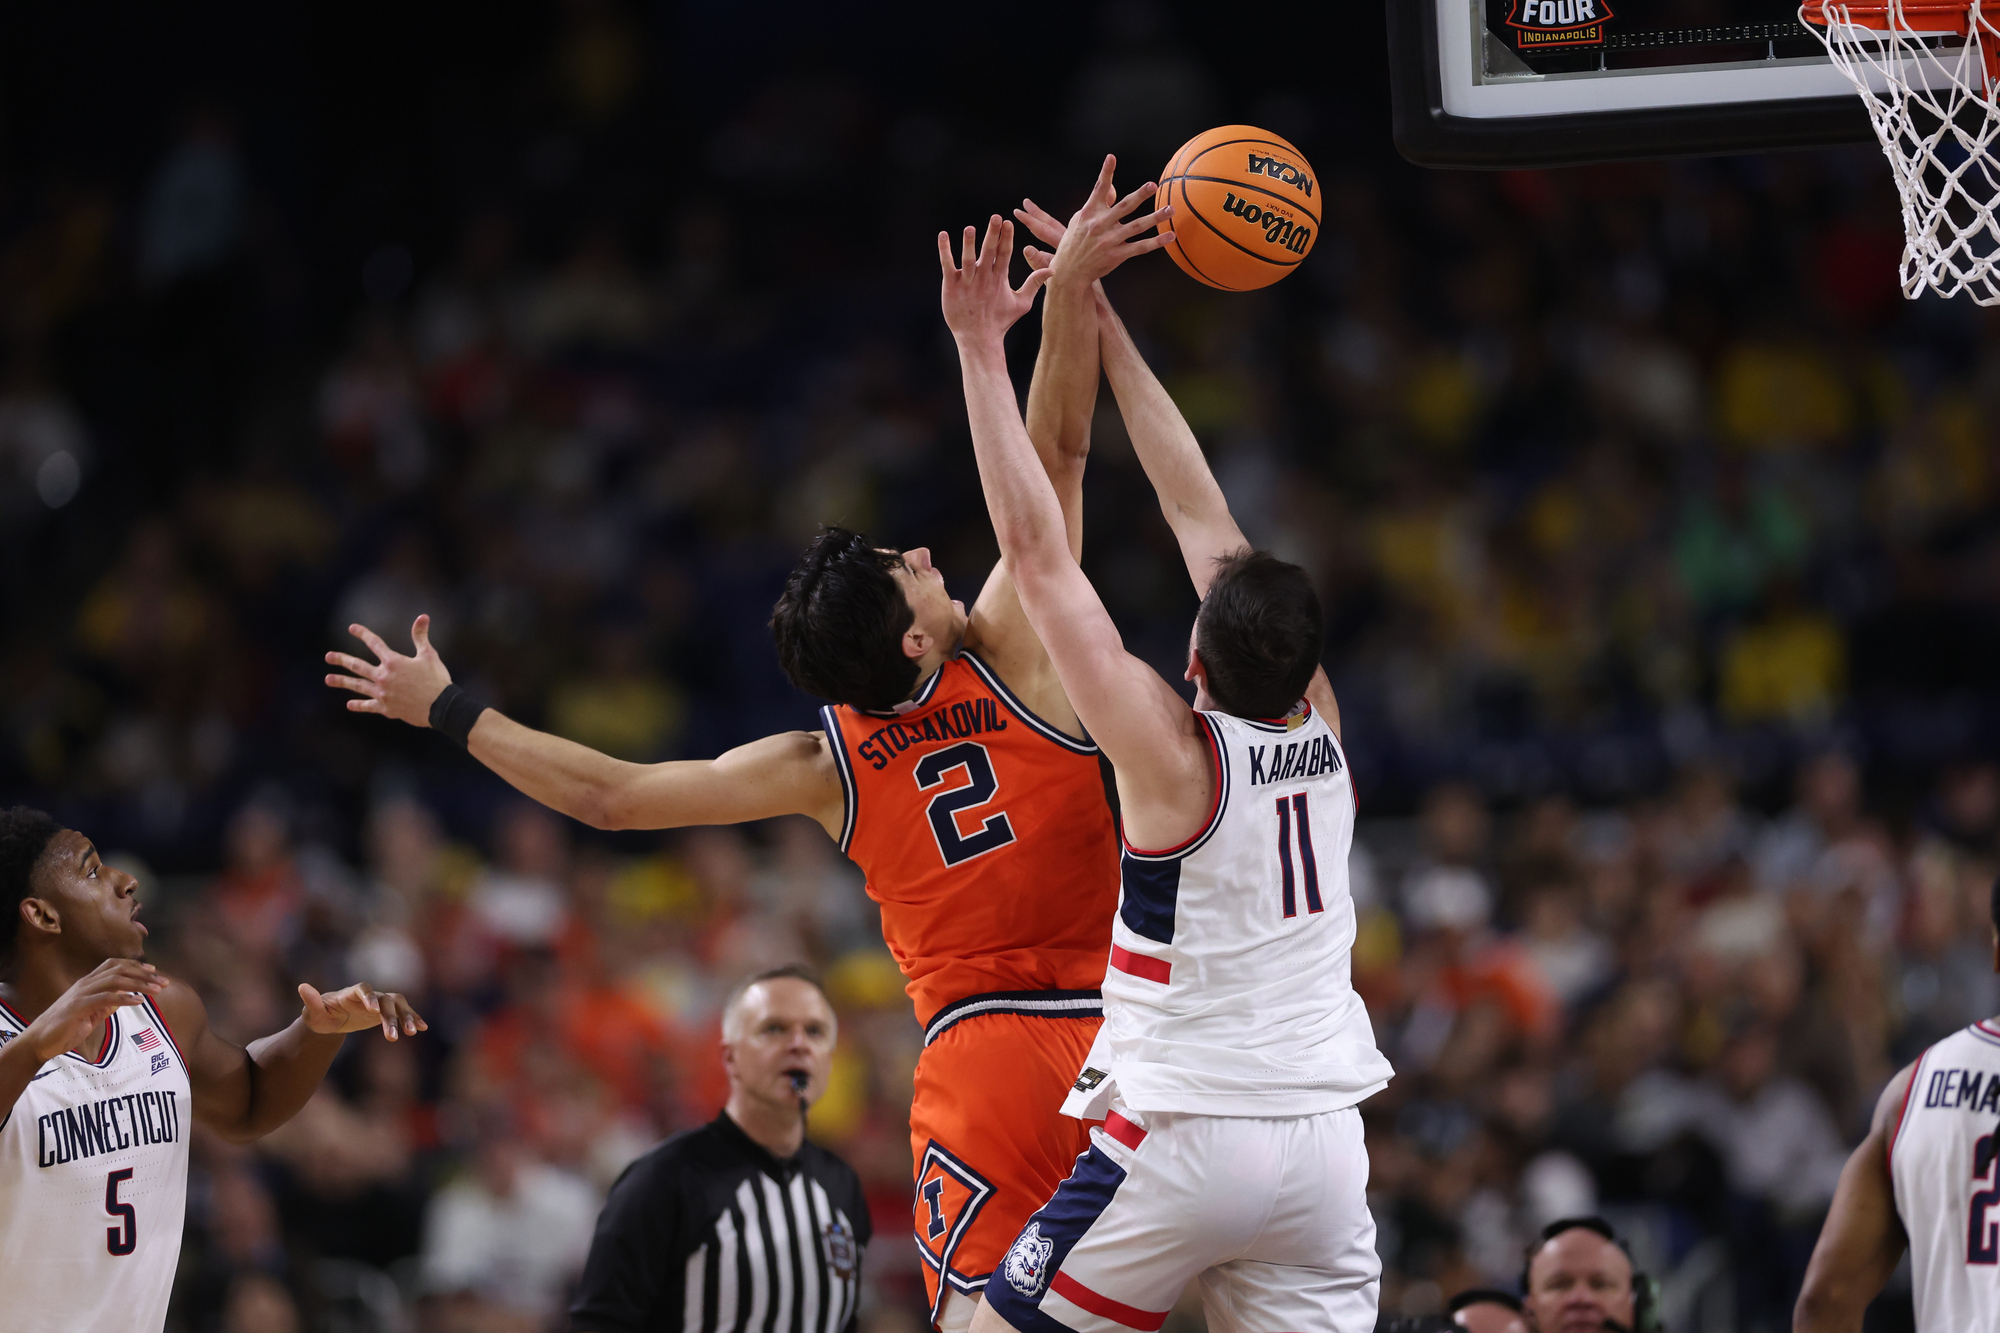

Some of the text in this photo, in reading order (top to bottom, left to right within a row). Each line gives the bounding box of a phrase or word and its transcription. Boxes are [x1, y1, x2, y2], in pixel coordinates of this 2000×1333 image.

[1522, 0, 1597, 25] FOUR
[1524, 27, 1596, 43] INDIANAPOLIS
[1247, 153, 1313, 198] NCAA
[1222, 192, 1311, 255] Wilson
[1266, 202, 1294, 218] EVO NXT
[858, 698, 1007, 770] STOJAKOVIC
[912, 740, 1018, 869] 2
[1276, 792, 1324, 918] 11
[151, 1051, 164, 1064] BIG
[151, 1057, 170, 1071] EAST
[1925, 1068, 2000, 1115] DEMA
[38, 1091, 178, 1168] CONNECTICUT
[105, 1167, 137, 1257] 5
[1966, 1133, 2000, 1265] 2
